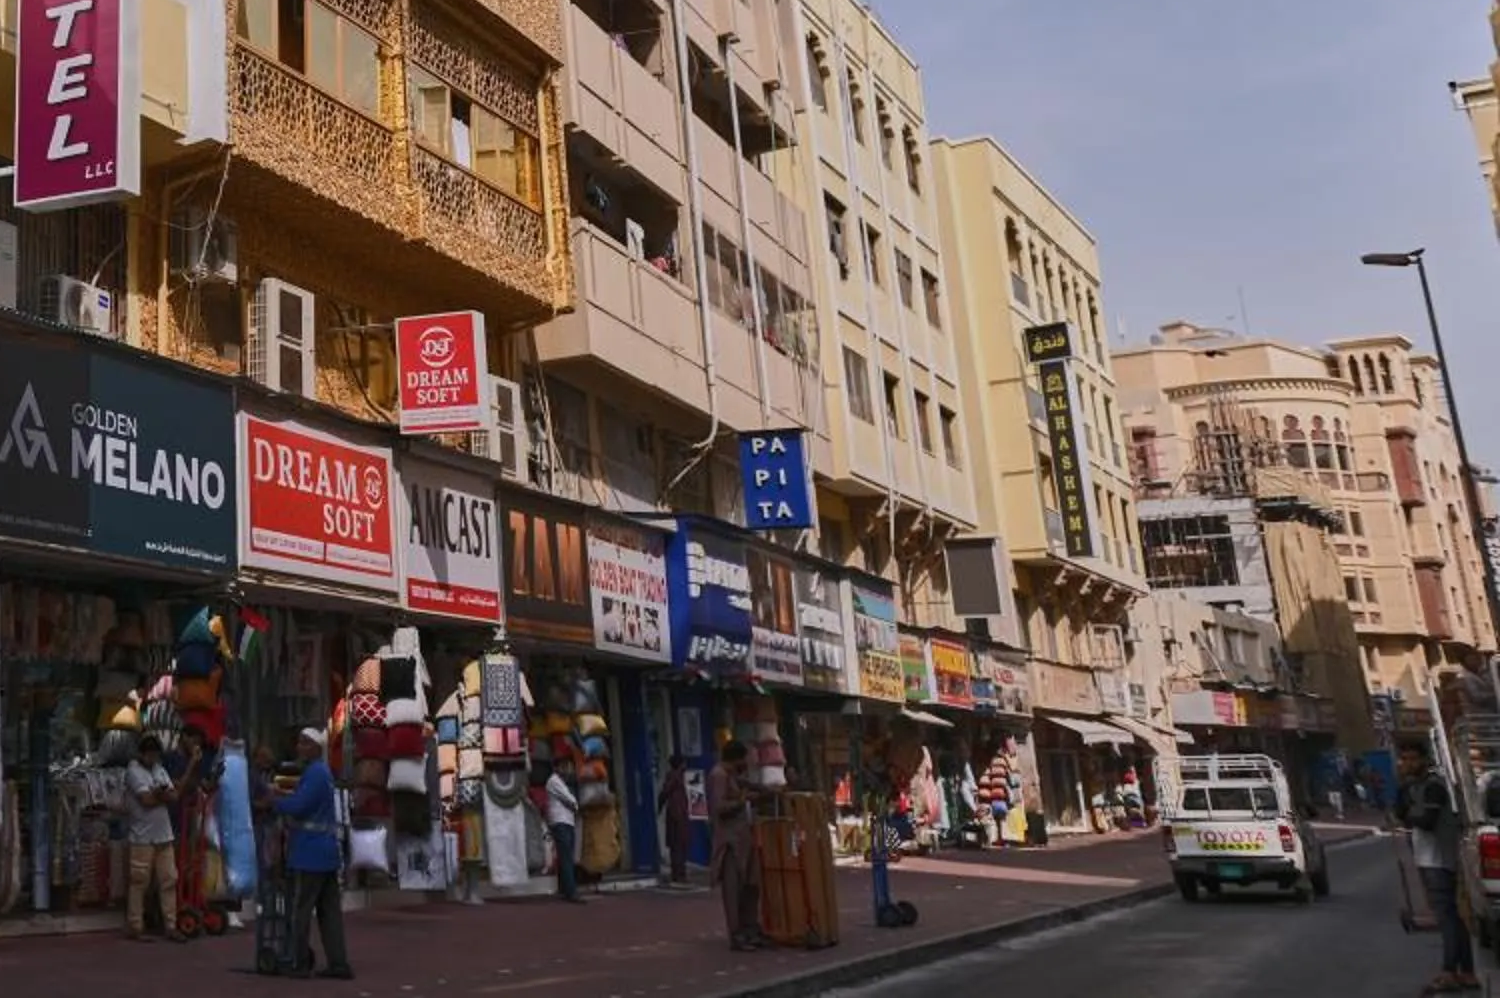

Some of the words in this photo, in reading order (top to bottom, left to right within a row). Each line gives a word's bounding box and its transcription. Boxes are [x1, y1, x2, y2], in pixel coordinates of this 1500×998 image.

[407, 367, 469, 388] DREAM
[416, 387, 461, 404] SOFT
[71, 402, 138, 438] GOLDEN
[1048, 395, 1068, 411] AL
[71, 428, 225, 509] MELANO
[253, 437, 360, 505] DREAM
[1054, 415, 1082, 550] HASHEMI
[324, 502, 375, 543] SOFT
[409, 483, 491, 559] AMCAST
[1195, 830, 1266, 844] TOYOTA
